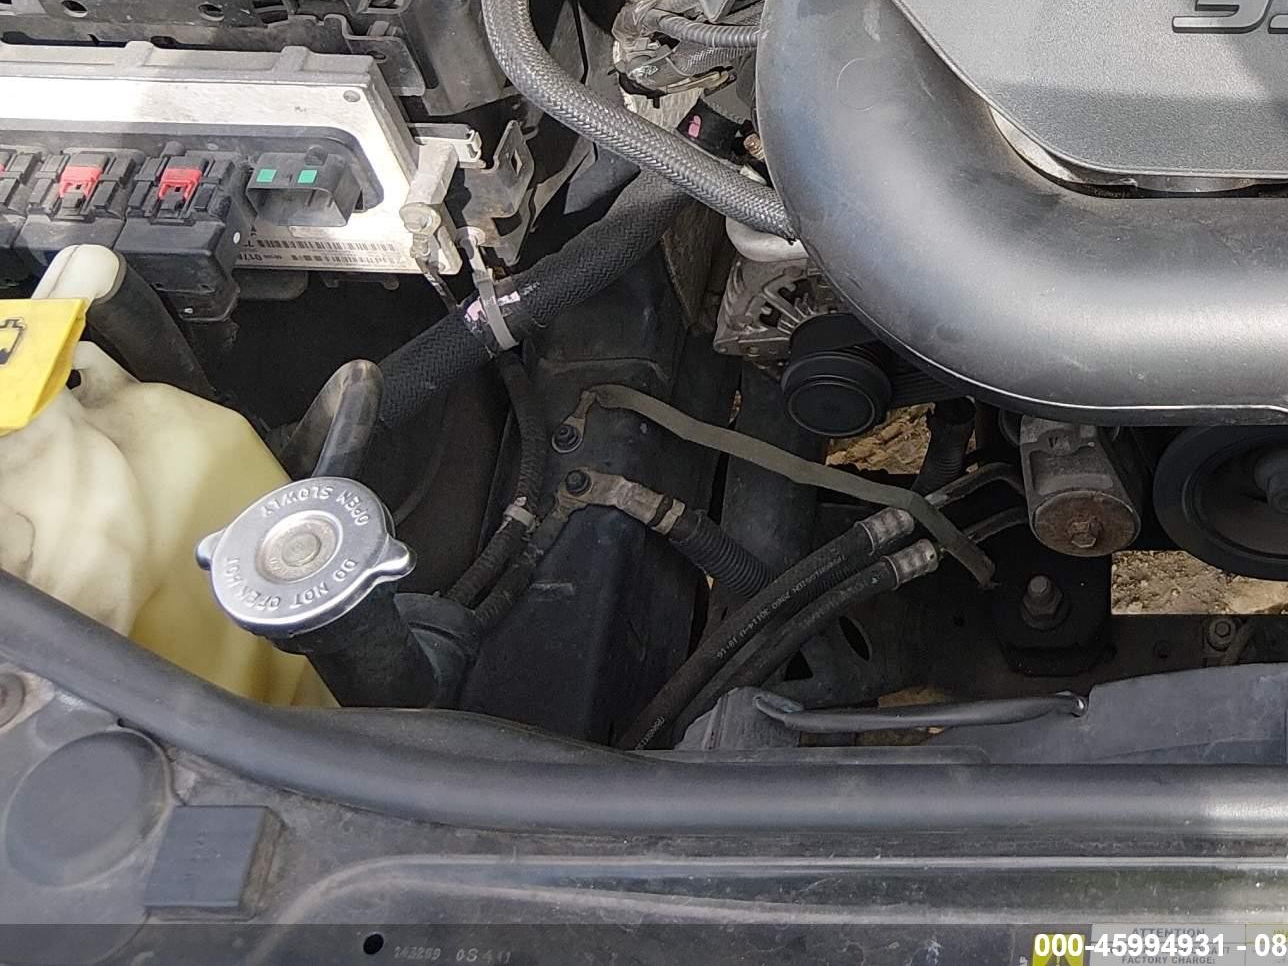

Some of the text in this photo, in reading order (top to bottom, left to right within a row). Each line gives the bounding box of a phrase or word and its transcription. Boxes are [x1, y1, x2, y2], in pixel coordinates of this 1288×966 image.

[260, 485, 370, 526] OPEN SLOWLY
[223, 557, 241, 588] HOT
[332, 557, 359, 582] DO
[236, 581, 281, 611] OPEN
[287, 581, 330, 610] NOT
[1132, 927, 1205, 938] ATTENTION
[1121, 955, 1168, 965] FACTORY
